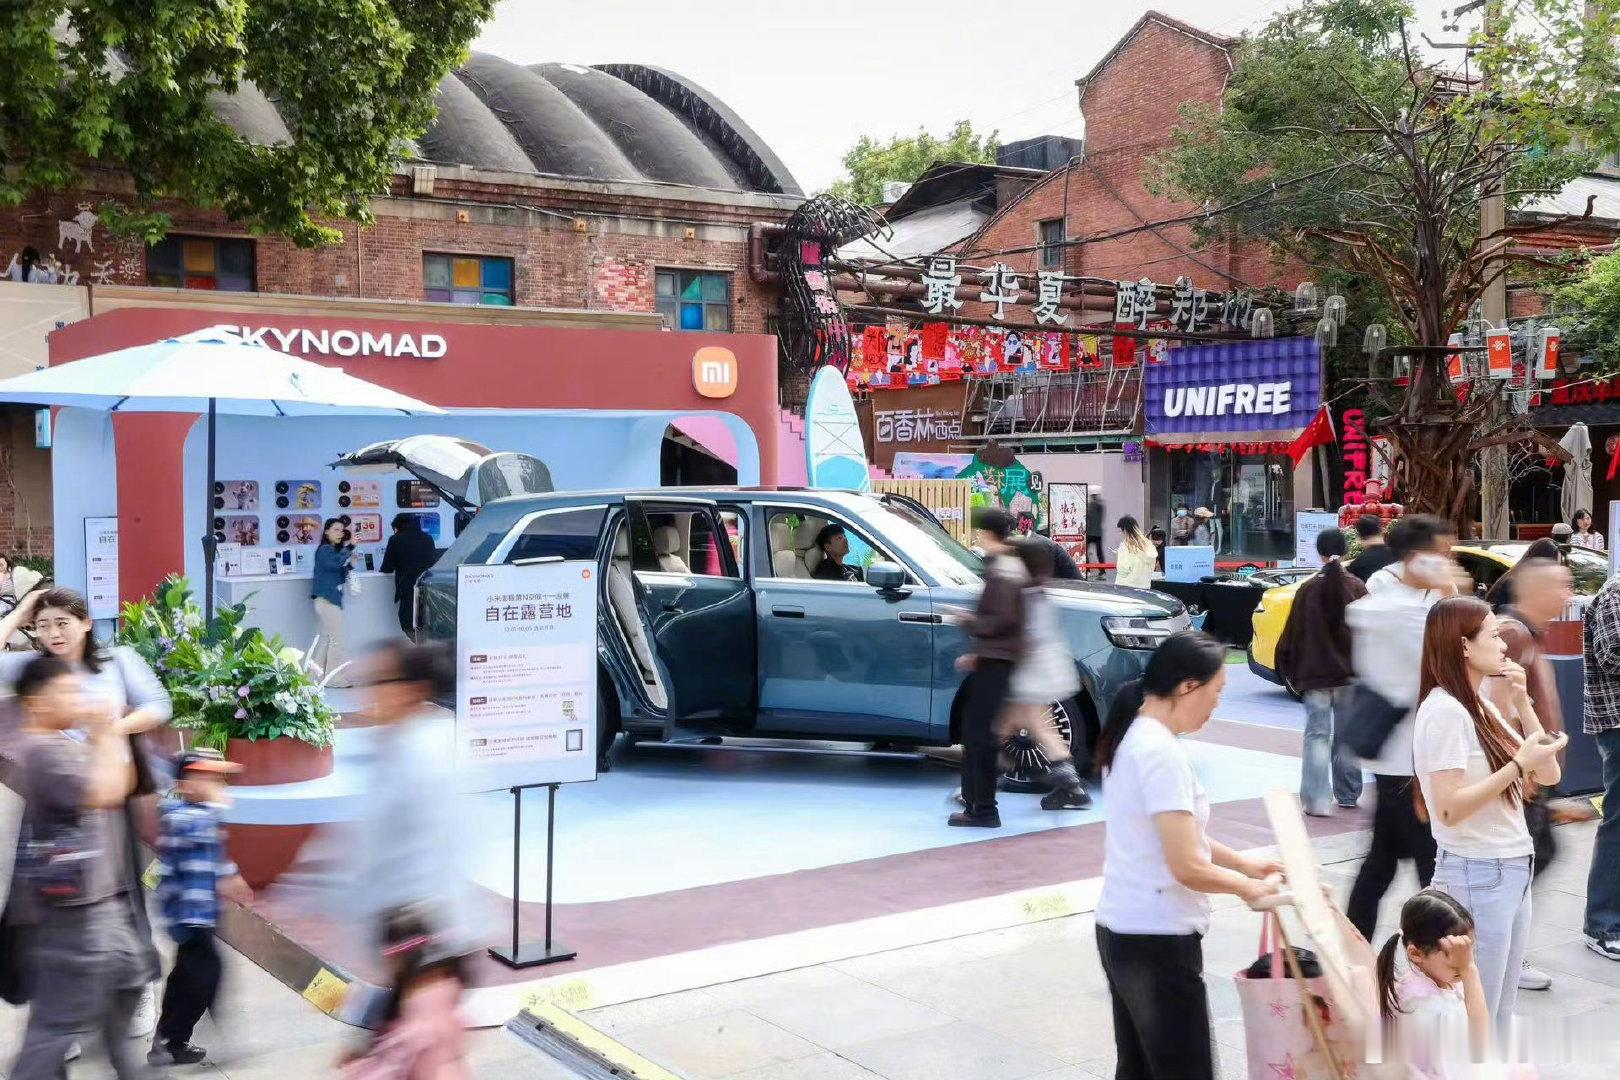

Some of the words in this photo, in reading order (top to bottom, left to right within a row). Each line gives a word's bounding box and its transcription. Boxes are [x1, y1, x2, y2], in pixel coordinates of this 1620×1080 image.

[920, 254, 1069, 325] 最华夏
[1164, 381, 1292, 417] UNIFREE
[486, 603, 572, 622] 自在露营地
